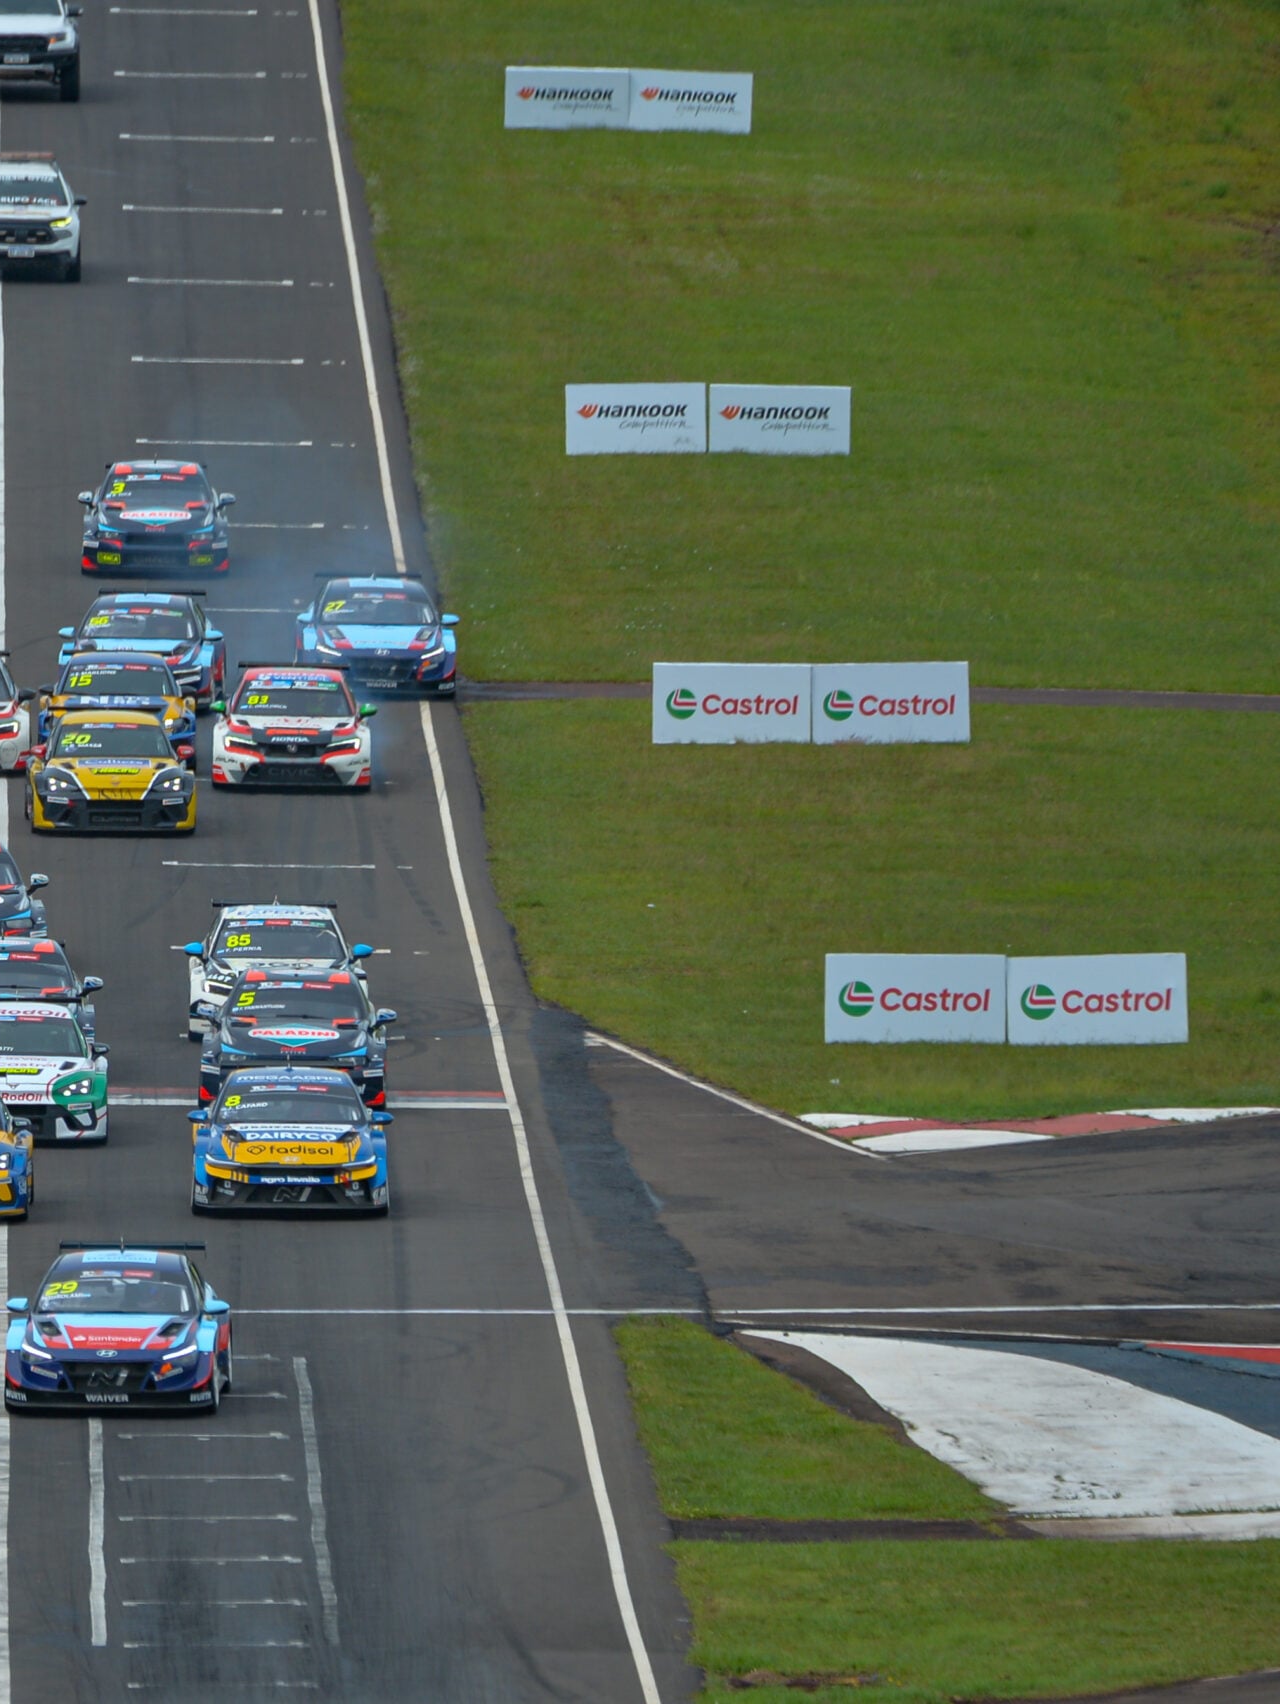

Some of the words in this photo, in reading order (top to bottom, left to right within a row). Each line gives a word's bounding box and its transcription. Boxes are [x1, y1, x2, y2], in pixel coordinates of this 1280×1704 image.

[111, 481, 126, 495] 3
[324, 600, 346, 613] 27
[70, 674, 93, 688] 15
[701, 693, 799, 715] Castrol
[858, 694, 956, 716] Castrol
[60, 734, 91, 746] 20
[226, 934, 251, 948] 85
[237, 991, 256, 1007] 5
[880, 987, 991, 1012] Castrol
[1061, 988, 1173, 1014] Castrol
[252, 1029, 336, 1037] PALADINI
[1, 1092, 42, 1102] RodOil
[224, 1095, 242, 1108] 8
[246, 1132, 338, 1142] DAIRYCO
[269, 1144, 334, 1156] fadisol
[44, 1280, 79, 1298] 29
[88, 1335, 143, 1343] Santander
[85, 1393, 130, 1404] WAIVER
